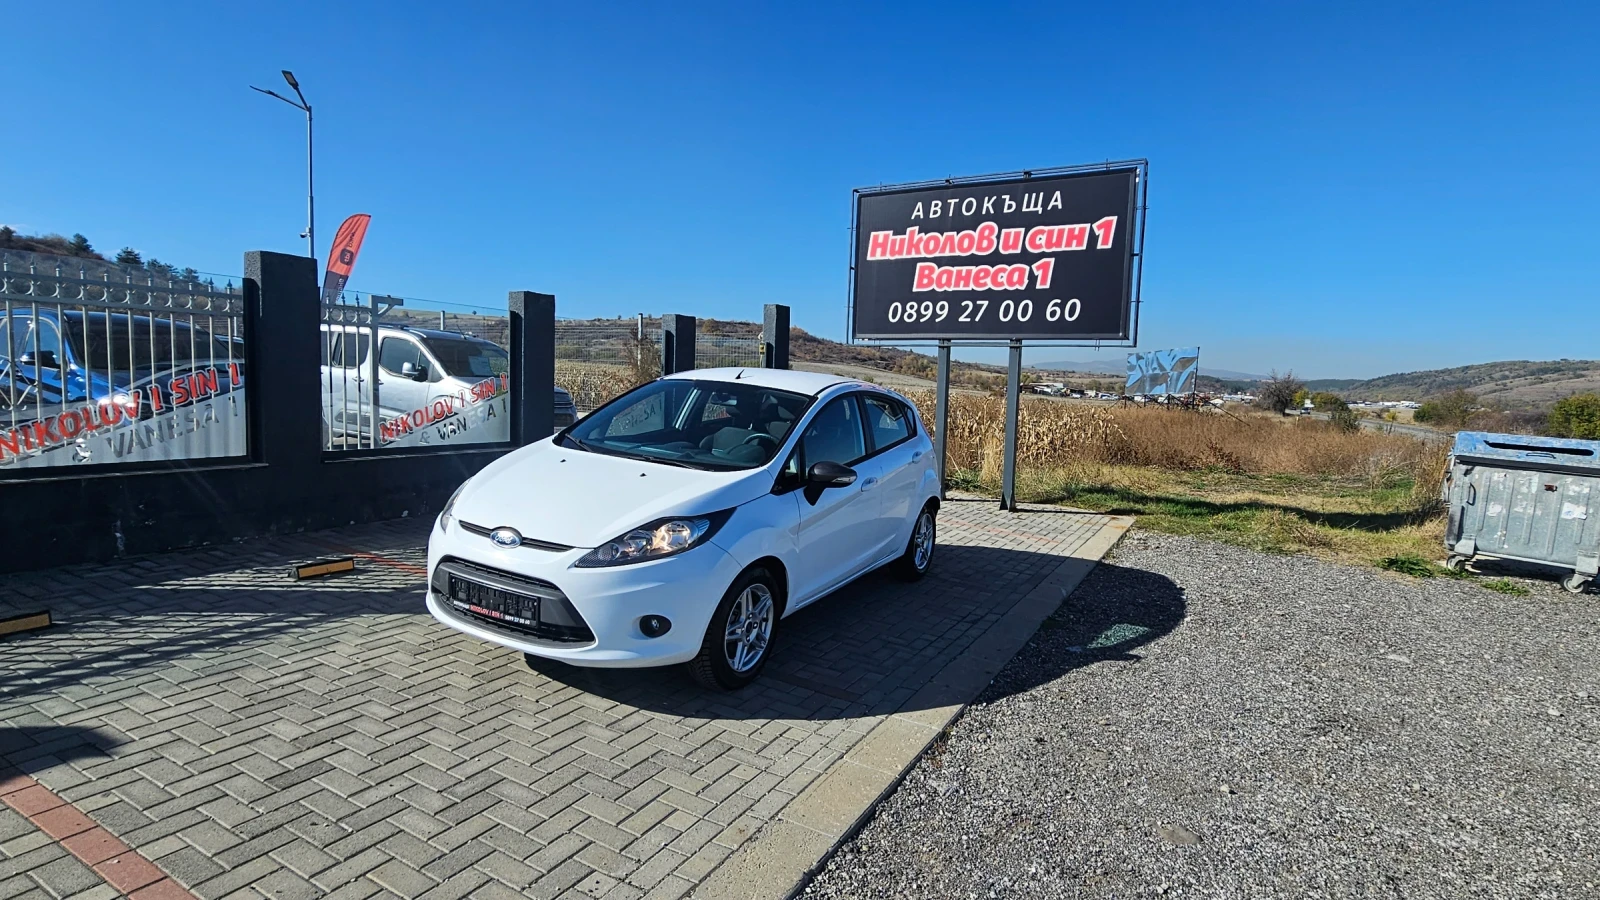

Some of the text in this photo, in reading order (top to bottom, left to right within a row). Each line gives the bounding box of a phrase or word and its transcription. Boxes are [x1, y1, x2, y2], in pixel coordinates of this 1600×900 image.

[911, 190, 1063, 220] АВТОКЪЩА
[866, 216, 1118, 261] Николов и син 1
[912, 257, 1055, 292] Ванеса 1
[888, 298, 1081, 323] 0899 27 00 60
[0, 390, 141, 460] NIKOLOV
[169, 367, 219, 405] SIN
[106, 403, 220, 458] VANESA
[379, 395, 455, 443] NIKOLOV
[470, 377, 496, 404] SIN
